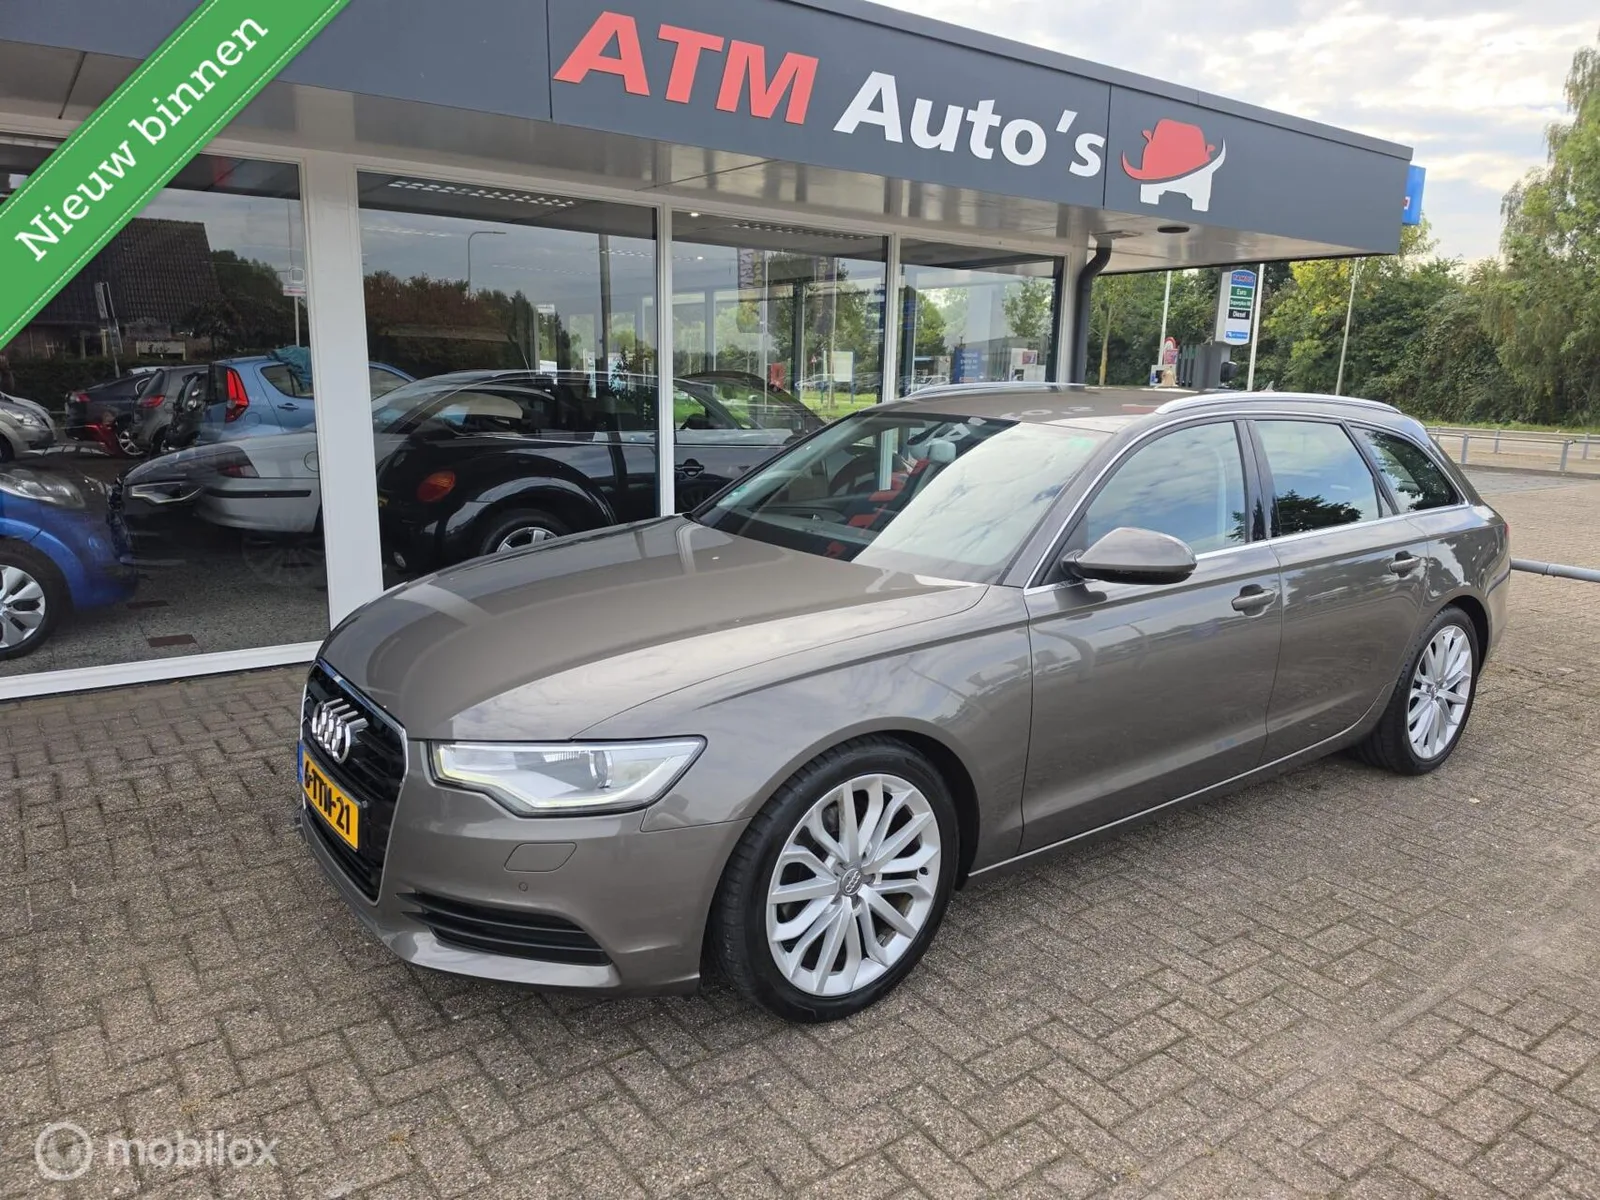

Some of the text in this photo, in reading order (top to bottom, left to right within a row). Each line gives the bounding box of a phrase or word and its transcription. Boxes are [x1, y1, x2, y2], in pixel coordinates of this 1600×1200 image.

[552, 11, 1106, 178] ATM Auto's
[1233, 310, 1247, 318] Diesel
